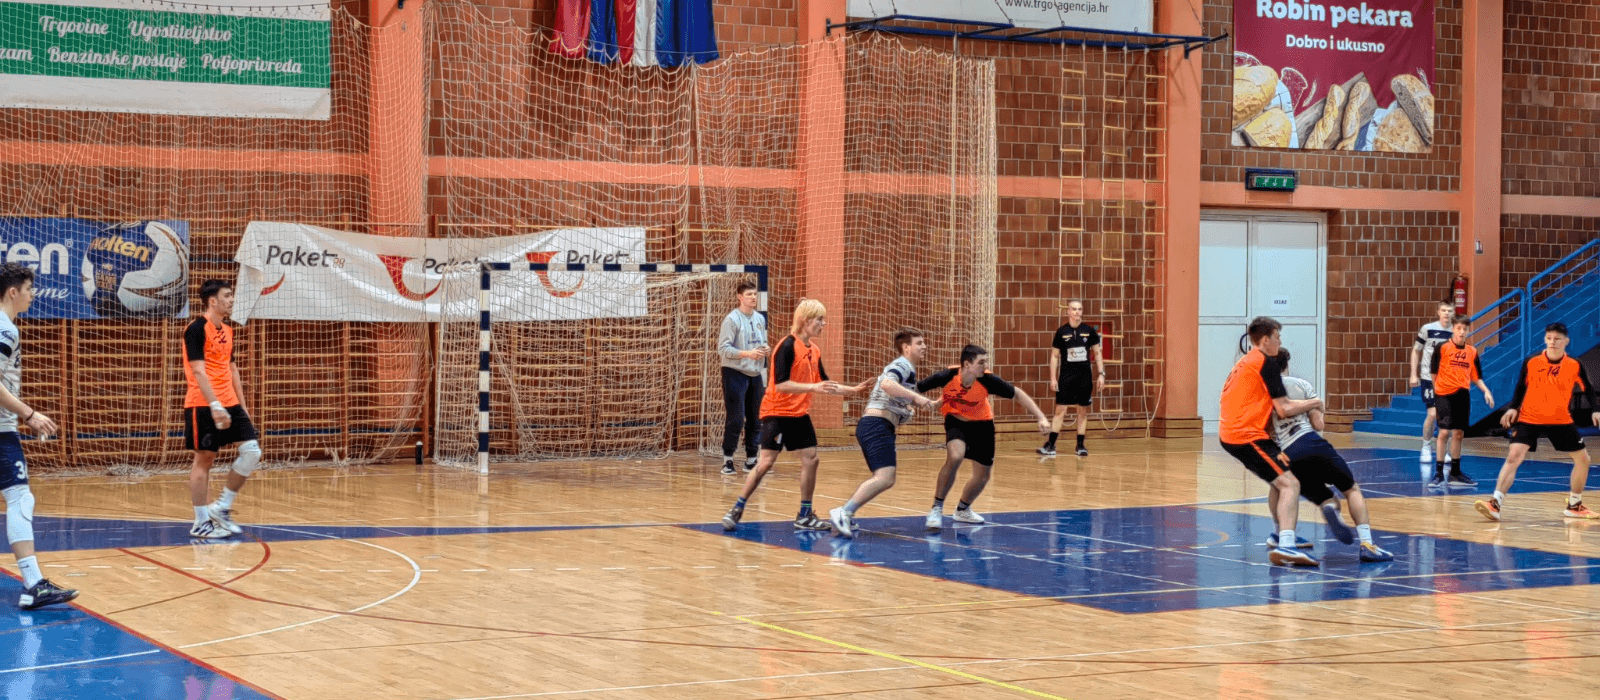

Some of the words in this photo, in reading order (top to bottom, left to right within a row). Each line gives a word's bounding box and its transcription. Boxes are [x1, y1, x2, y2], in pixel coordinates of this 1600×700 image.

[1256, 0, 1325, 21] Robin
[1330, 3, 1413, 28] pekara
[39, 15, 109, 38] Trgovine
[128, 20, 232, 44] Ugostiteljstvo
[1286, 34, 1327, 49] Dobro
[1330, 35, 1334, 50] i
[1337, 37, 1386, 53] ukusno
[47, 46, 131, 66] Benzinske
[131, 53, 187, 73] postaje
[200, 53, 302, 75] Poljoprivreda
[265, 244, 338, 267] Paket
[1424, 388, 1434, 399] 41
